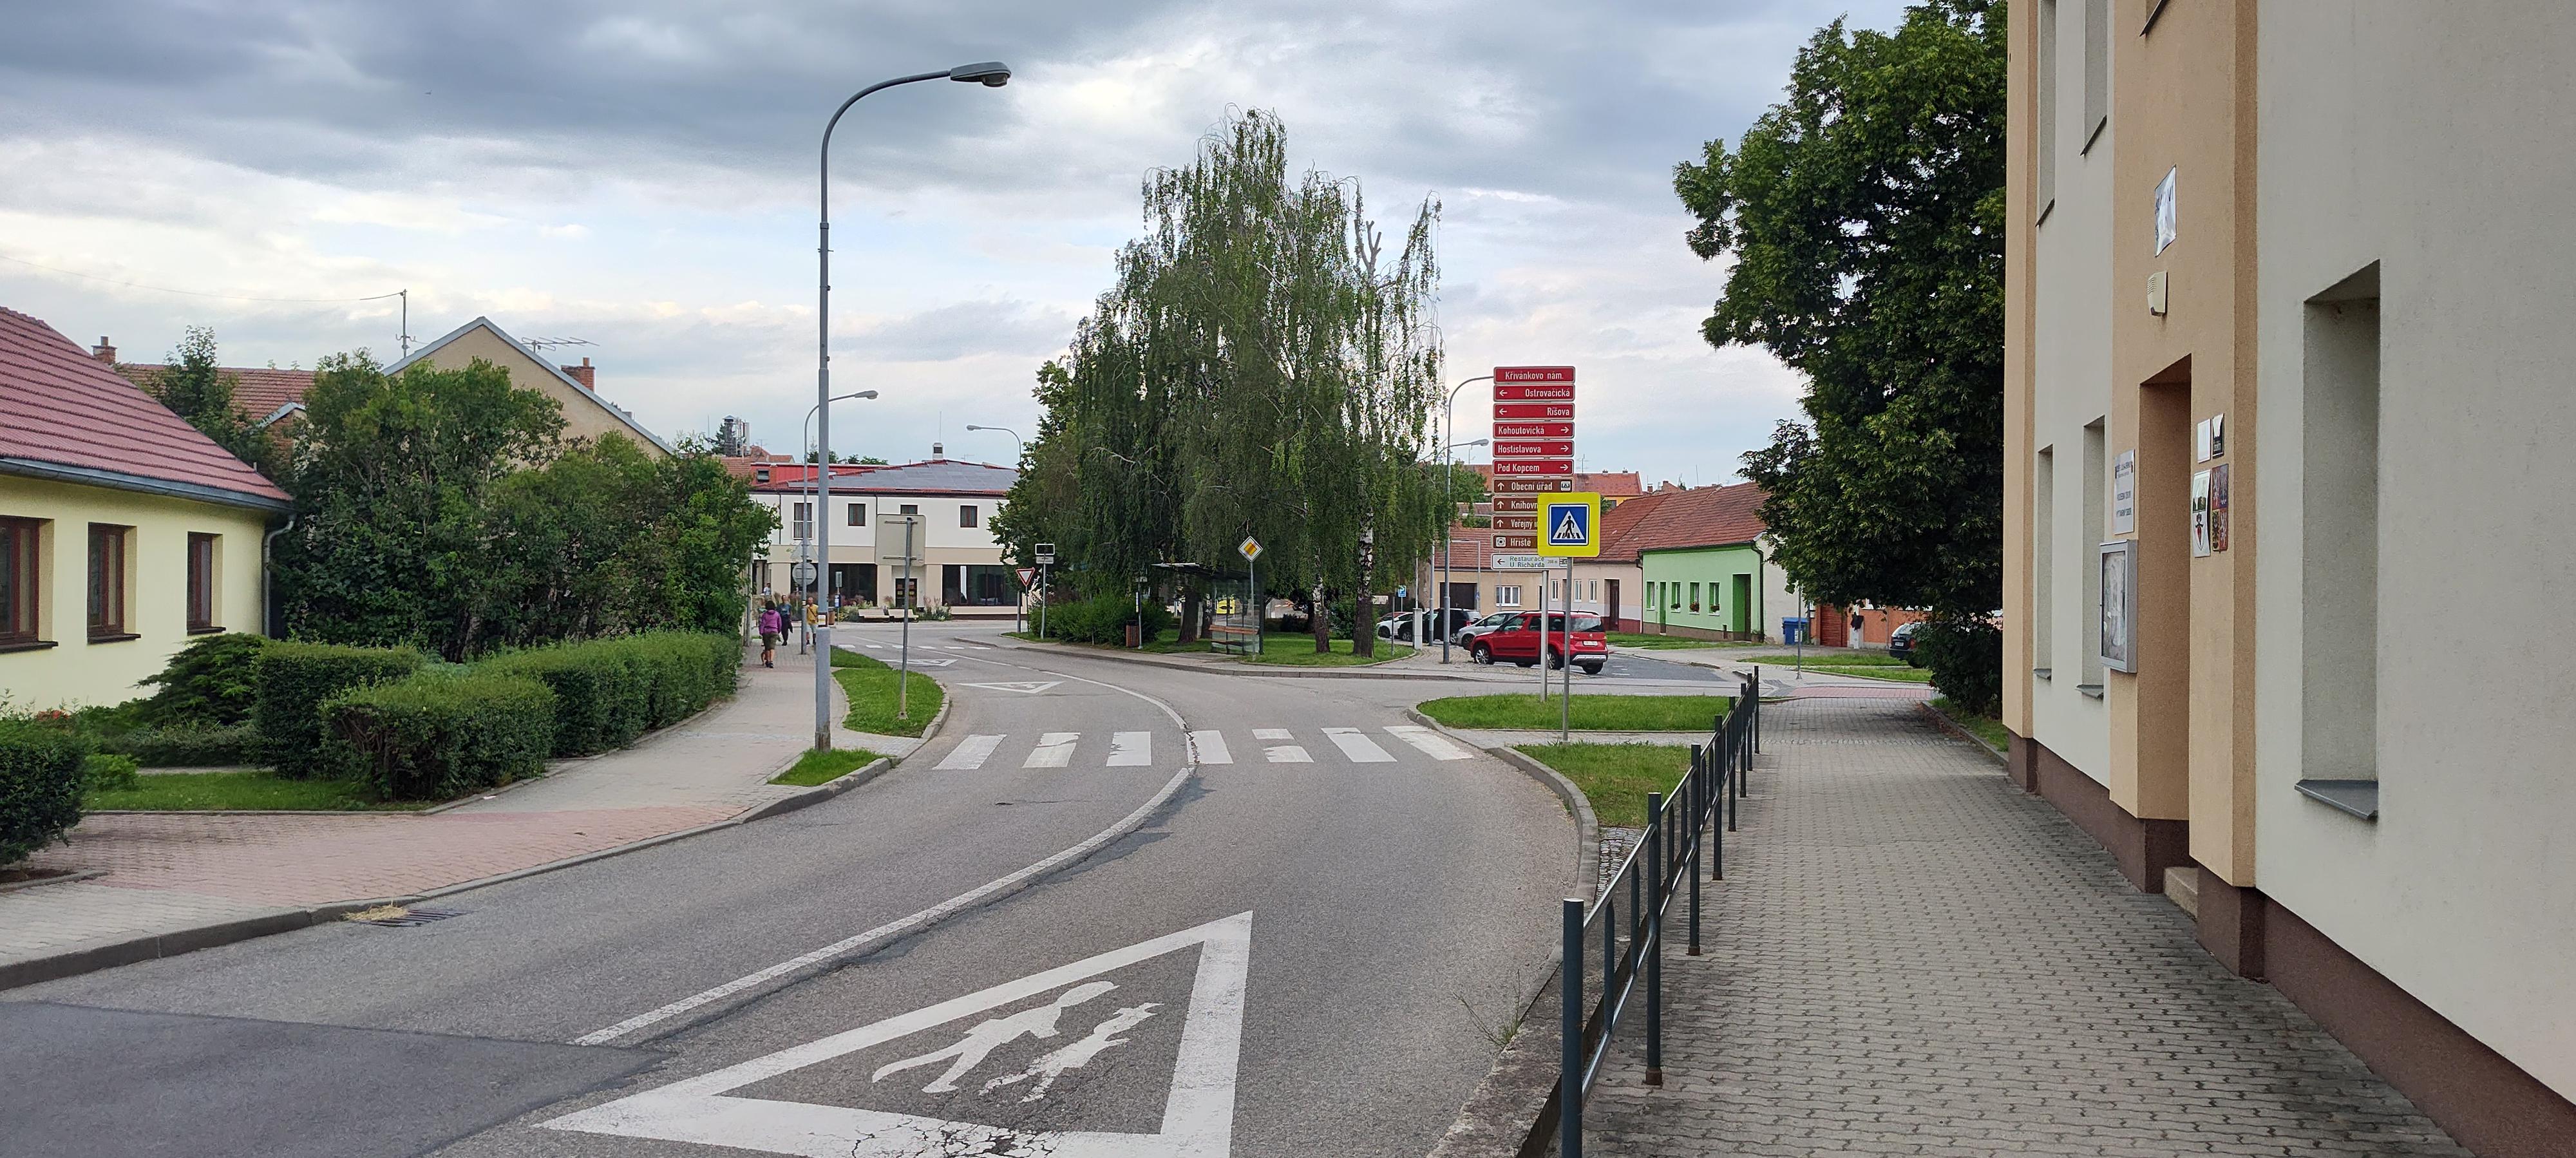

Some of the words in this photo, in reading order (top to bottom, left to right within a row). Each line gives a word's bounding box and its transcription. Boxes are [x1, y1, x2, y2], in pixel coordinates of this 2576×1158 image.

[1547, 371, 1564, 379] nám.
[1498, 444, 1542, 453] Hostislavova
[1497, 463, 1510, 472] Pod
[1513, 463, 1540, 473] Kopcem
[1511, 482, 1535, 491] Obecní
[1511, 500, 1538, 509] Knihovn
